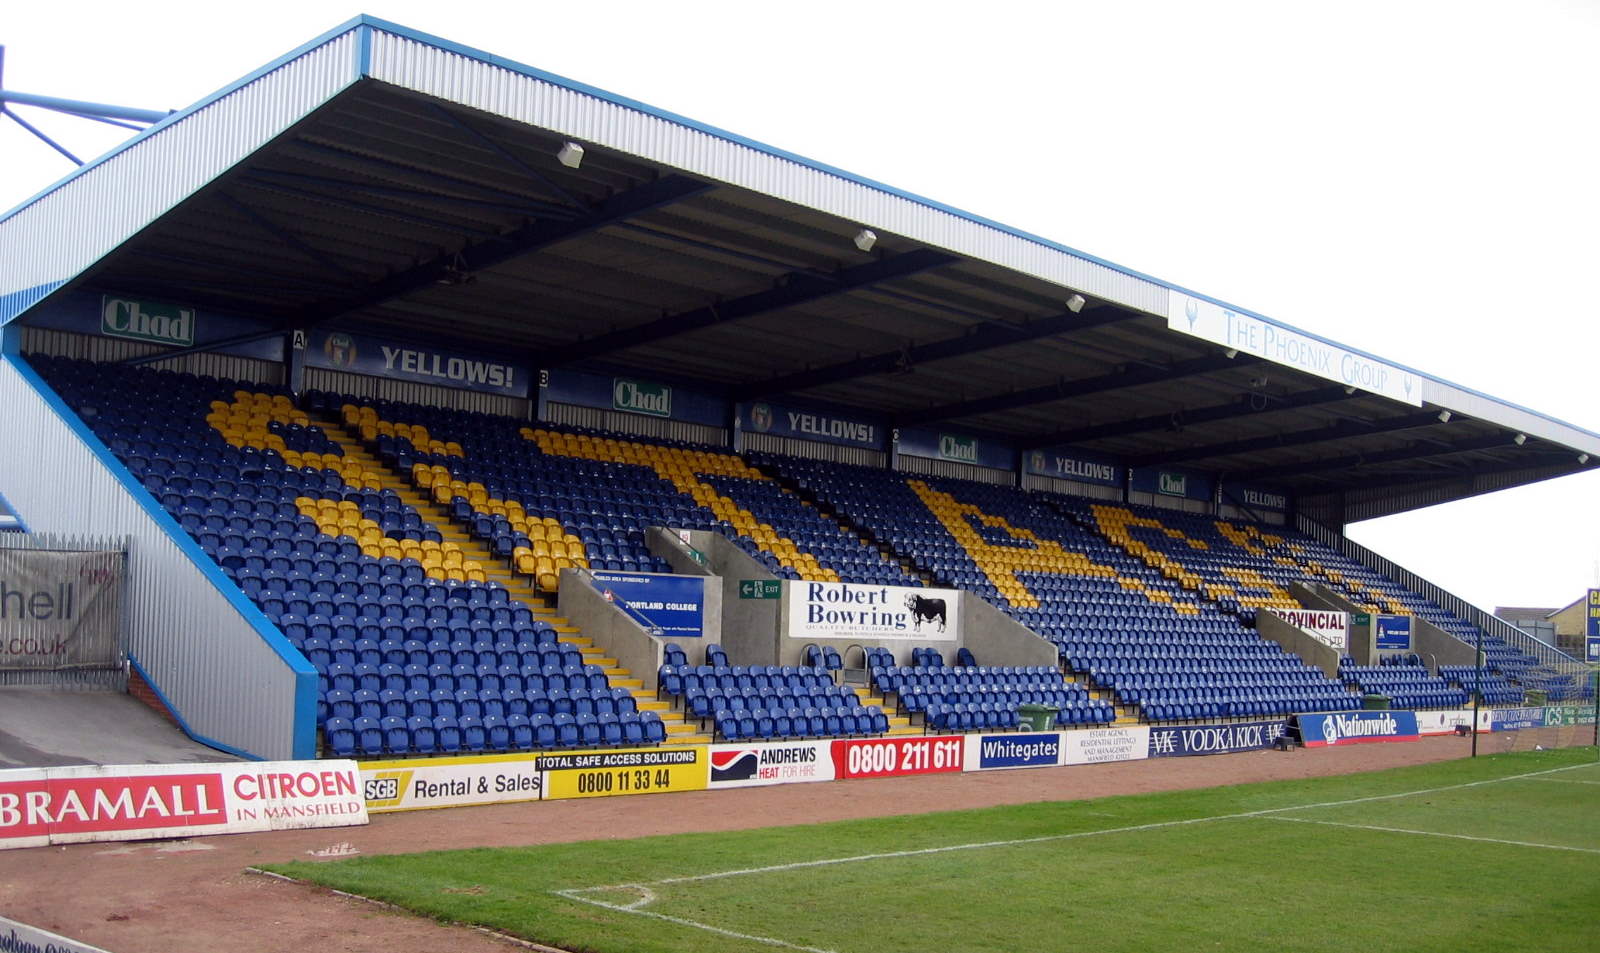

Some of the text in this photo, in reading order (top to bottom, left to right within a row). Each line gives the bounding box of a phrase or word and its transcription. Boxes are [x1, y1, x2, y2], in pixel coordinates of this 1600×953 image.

[104, 299, 190, 341] Chad
[294, 332, 304, 347] A
[1224, 311, 1389, 391] THE PHOENIX GROUP
[381, 346, 513, 388] YELLOWS!
[616, 382, 669, 413] Chad
[788, 412, 874, 443] YELLOWS!
[941, 436, 976, 459] Chad
[1055, 457, 1114, 481] YELLOWS!
[1160, 473, 1185, 495] Chad
[1243, 489, 1286, 508] YELLOWS!
[0, 581, 74, 620] hell
[765, 585, 778, 593] EXIT
[808, 582, 888, 604] Robert
[666, 602, 698, 612] COLLEGE
[808, 604, 907, 630] Bowring
[0, 634, 67, 656] .co.uk
[1335, 712, 1397, 737] Nationwide
[1544, 707, 1562, 726] ICS
[1152, 731, 1177, 753] VK
[1181, 726, 1234, 752] VODKA
[1235, 725, 1263, 748] KICK
[576, 755, 601, 767] SAFE
[603, 753, 641, 766] ACCESS
[644, 751, 695, 764] SOLUTIONS
[760, 747, 817, 765] ANDREWS
[849, 740, 961, 774] 0800 211 611
[983, 741, 1058, 761] Whitegates
[578, 768, 671, 793] 0800 11 33 44
[760, 764, 816, 779] HEAT FOR HIRE
[233, 770, 357, 801] CITROEN
[364, 779, 398, 799] SGB
[414, 775, 540, 799] Rental & Sales
[0, 784, 220, 827] BRAMALL
[237, 801, 361, 821] IN MANSFIELD
